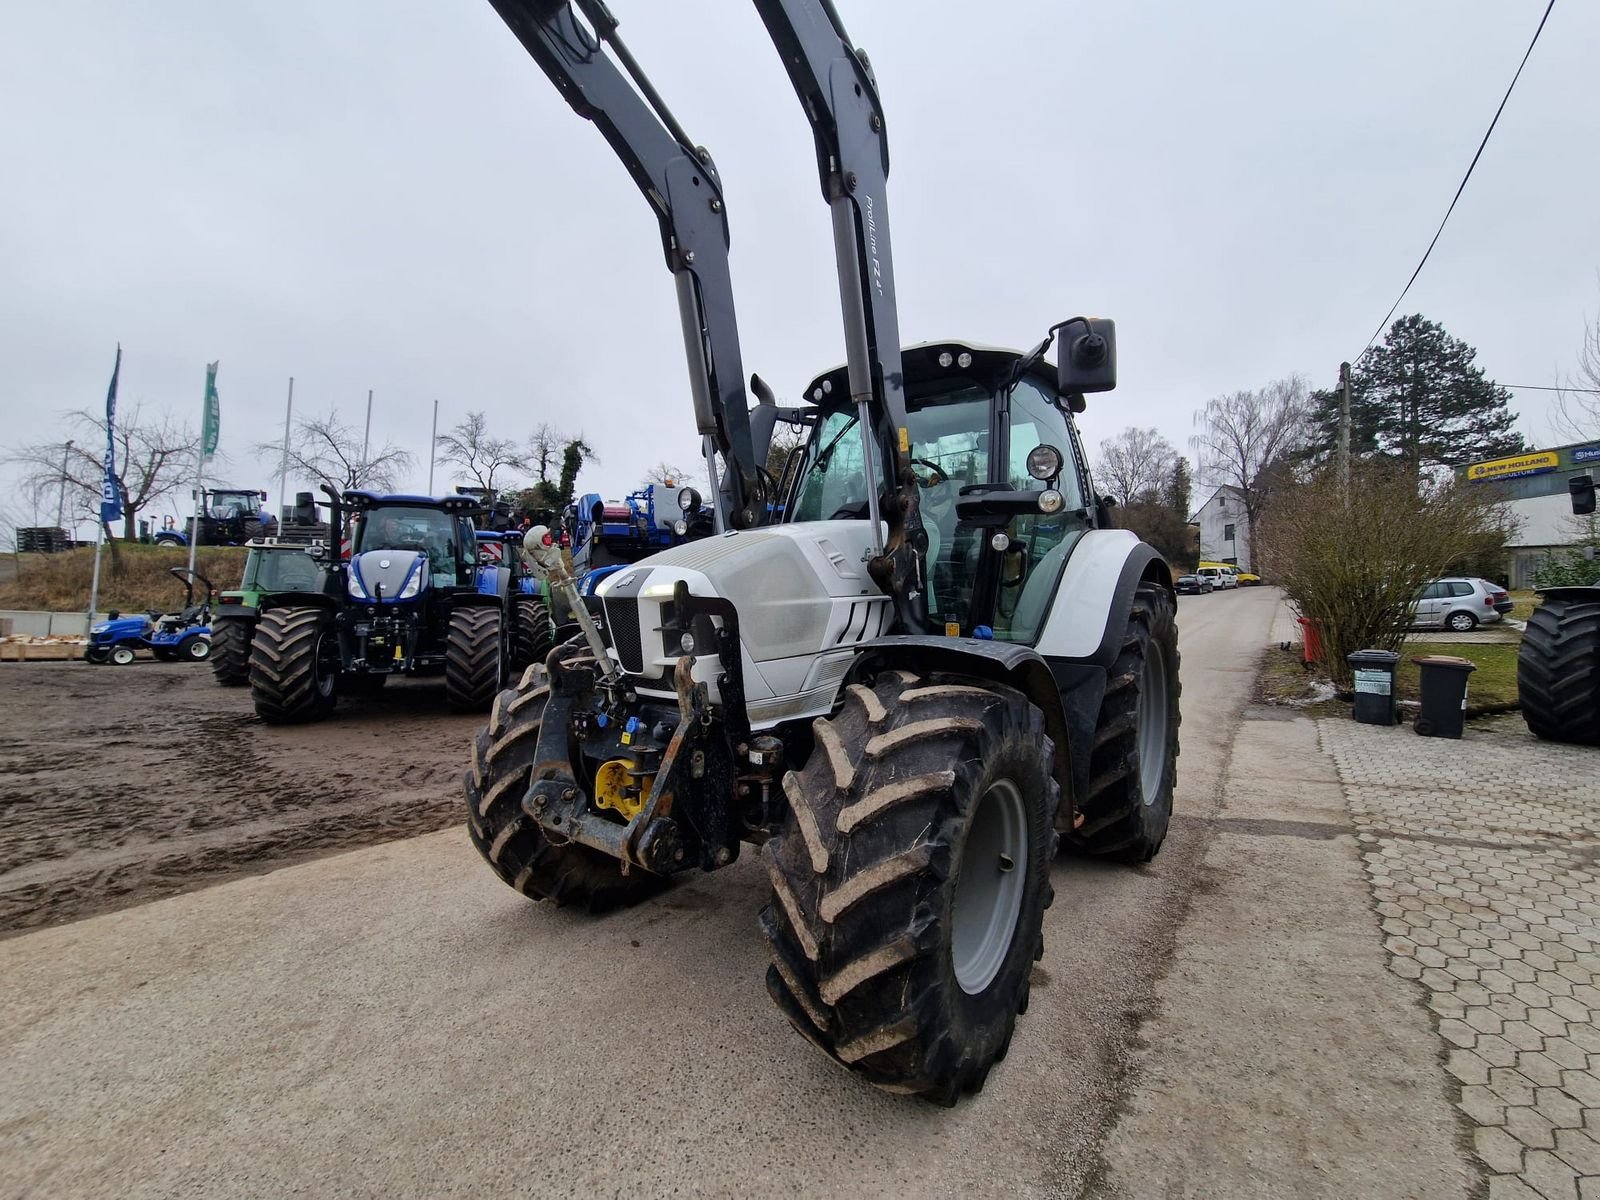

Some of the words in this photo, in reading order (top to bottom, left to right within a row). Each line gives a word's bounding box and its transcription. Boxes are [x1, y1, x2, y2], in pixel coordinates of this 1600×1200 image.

[866, 195, 877, 253] ProfiLine
[872, 258, 881, 277] FZ
[1487, 464, 1507, 472] NEW
[1508, 457, 1549, 468] HOLLAND
